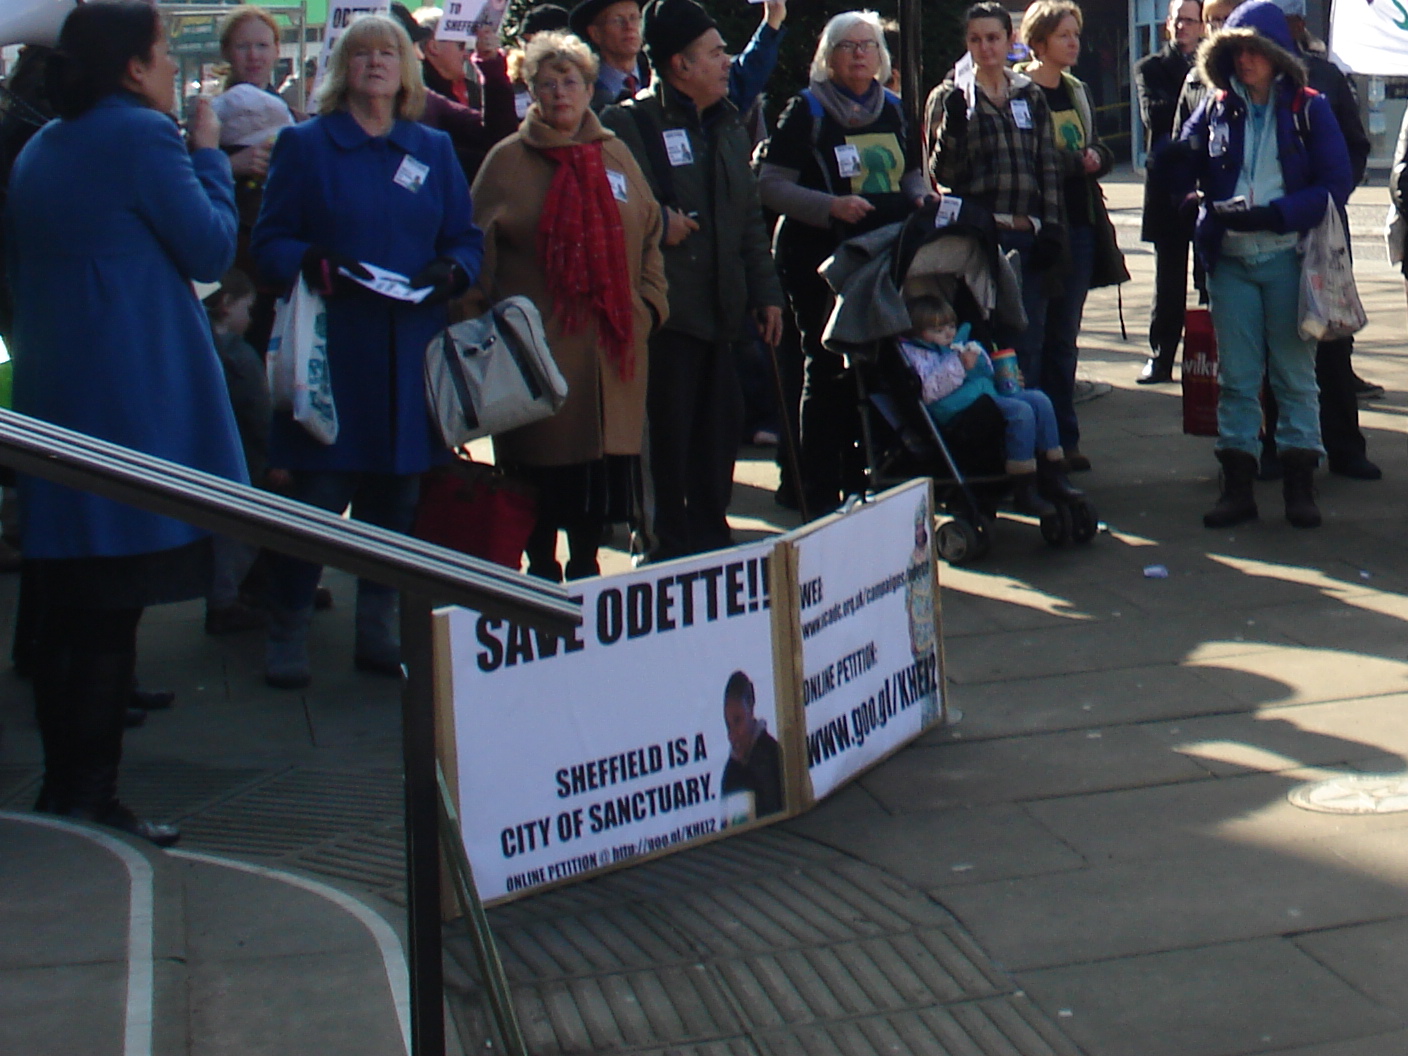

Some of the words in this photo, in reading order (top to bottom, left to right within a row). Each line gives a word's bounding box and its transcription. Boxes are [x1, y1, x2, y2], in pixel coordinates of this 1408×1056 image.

[449, 2, 462, 15] TO
[1181, 351, 1219, 377] wilk
[596, 556, 771, 645] ODETTE!!
[803, 663, 835, 707] ONLINE
[556, 743, 662, 799] SHEFFIELD
[667, 737, 689, 769] IS
[694, 732, 708, 762] A
[500, 816, 551, 859] CITY
[556, 808, 583, 842] OF
[588, 772, 716, 834] SANCTUARY.
[505, 867, 548, 893] ONLINE
[549, 852, 598, 881] PETITION
